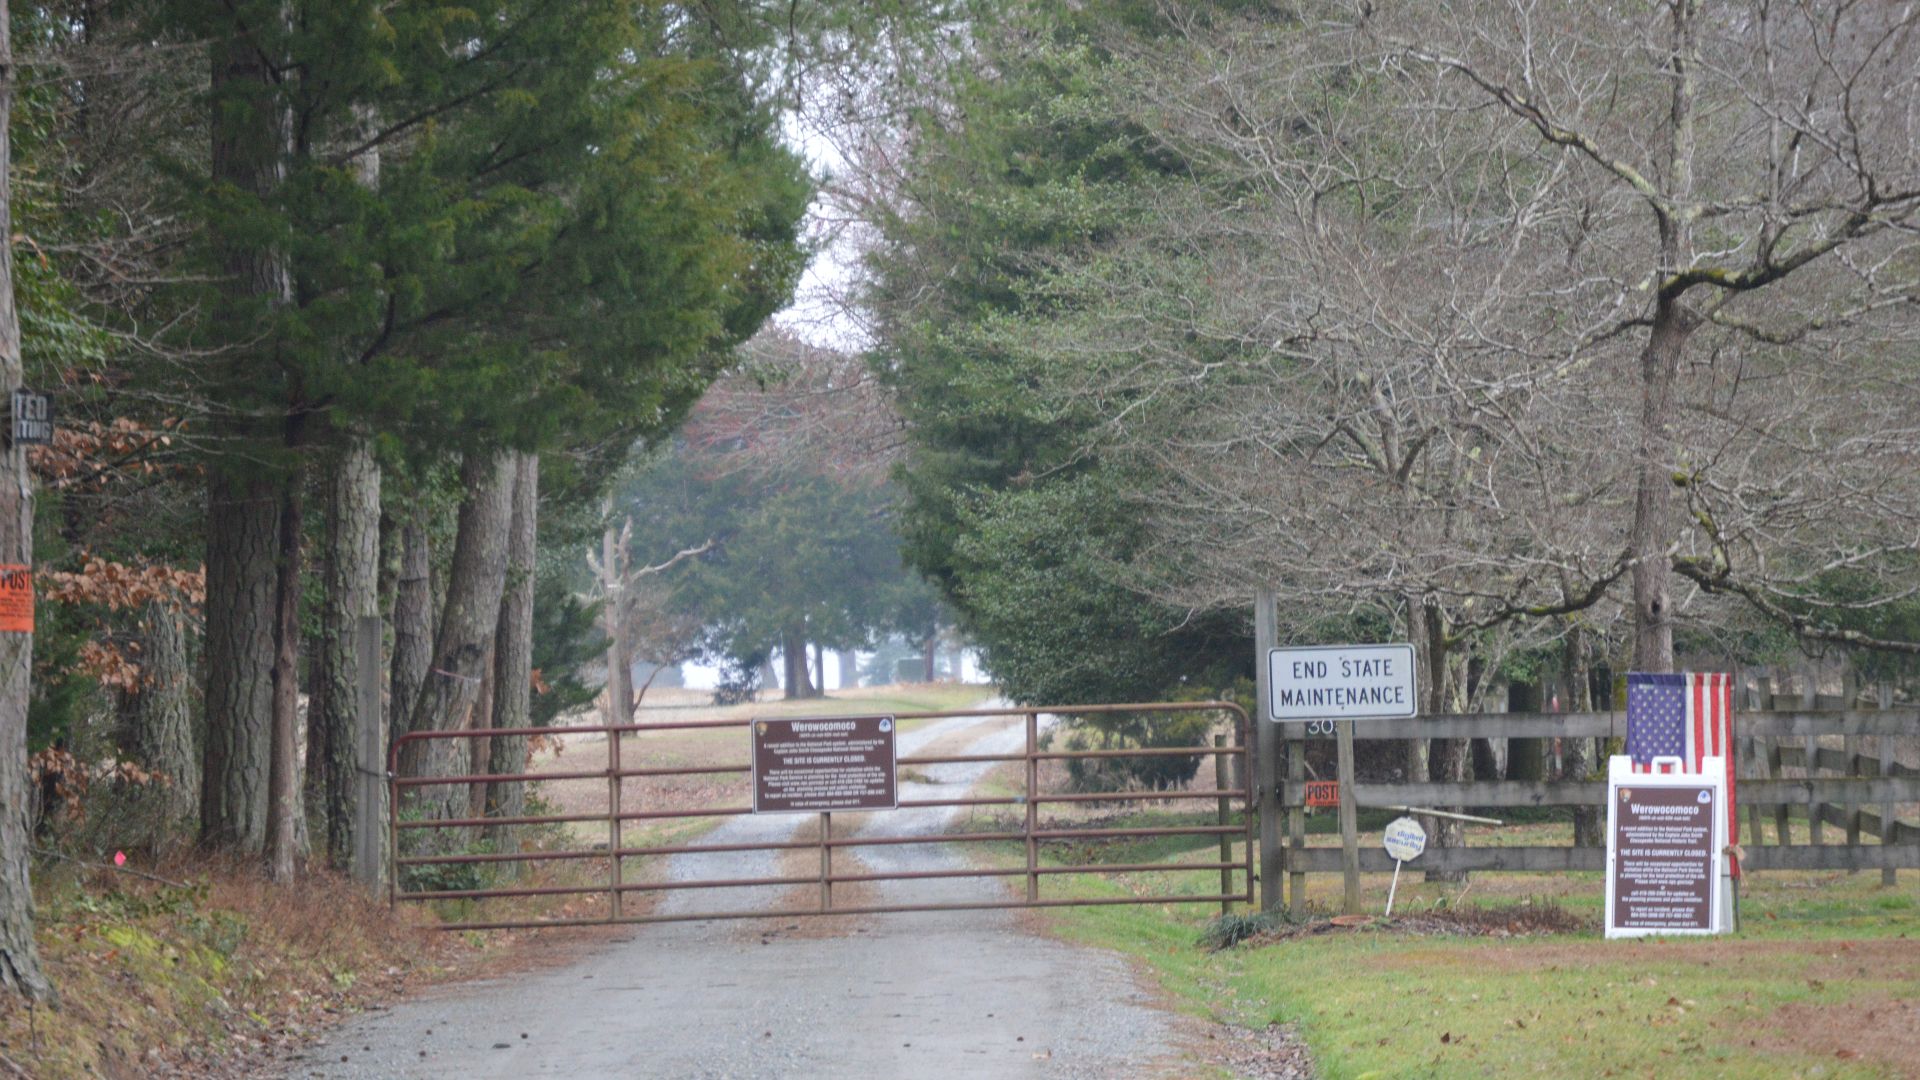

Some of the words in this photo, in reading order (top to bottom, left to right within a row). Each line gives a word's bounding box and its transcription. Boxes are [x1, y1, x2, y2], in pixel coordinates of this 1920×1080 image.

[1293, 661, 1327, 679] END
[1342, 659, 1393, 678] STATE
[1281, 686, 1404, 706] MAINTENANCE
[791, 721, 856, 732] Werowocomoco
[1308, 719, 1338, 735] 30
[783, 757, 793, 765] THE
[794, 756, 805, 765] SITE
[806, 756, 812, 765] IS
[813, 755, 843, 764] CURRENTLY
[1631, 804, 1699, 815] Werowocomoco
[1620, 849, 1631, 857] THE
[1632, 849, 1644, 857] SITE
[1645, 849, 1651, 857] IS
[1652, 849, 1683, 857] CURRENTLY
